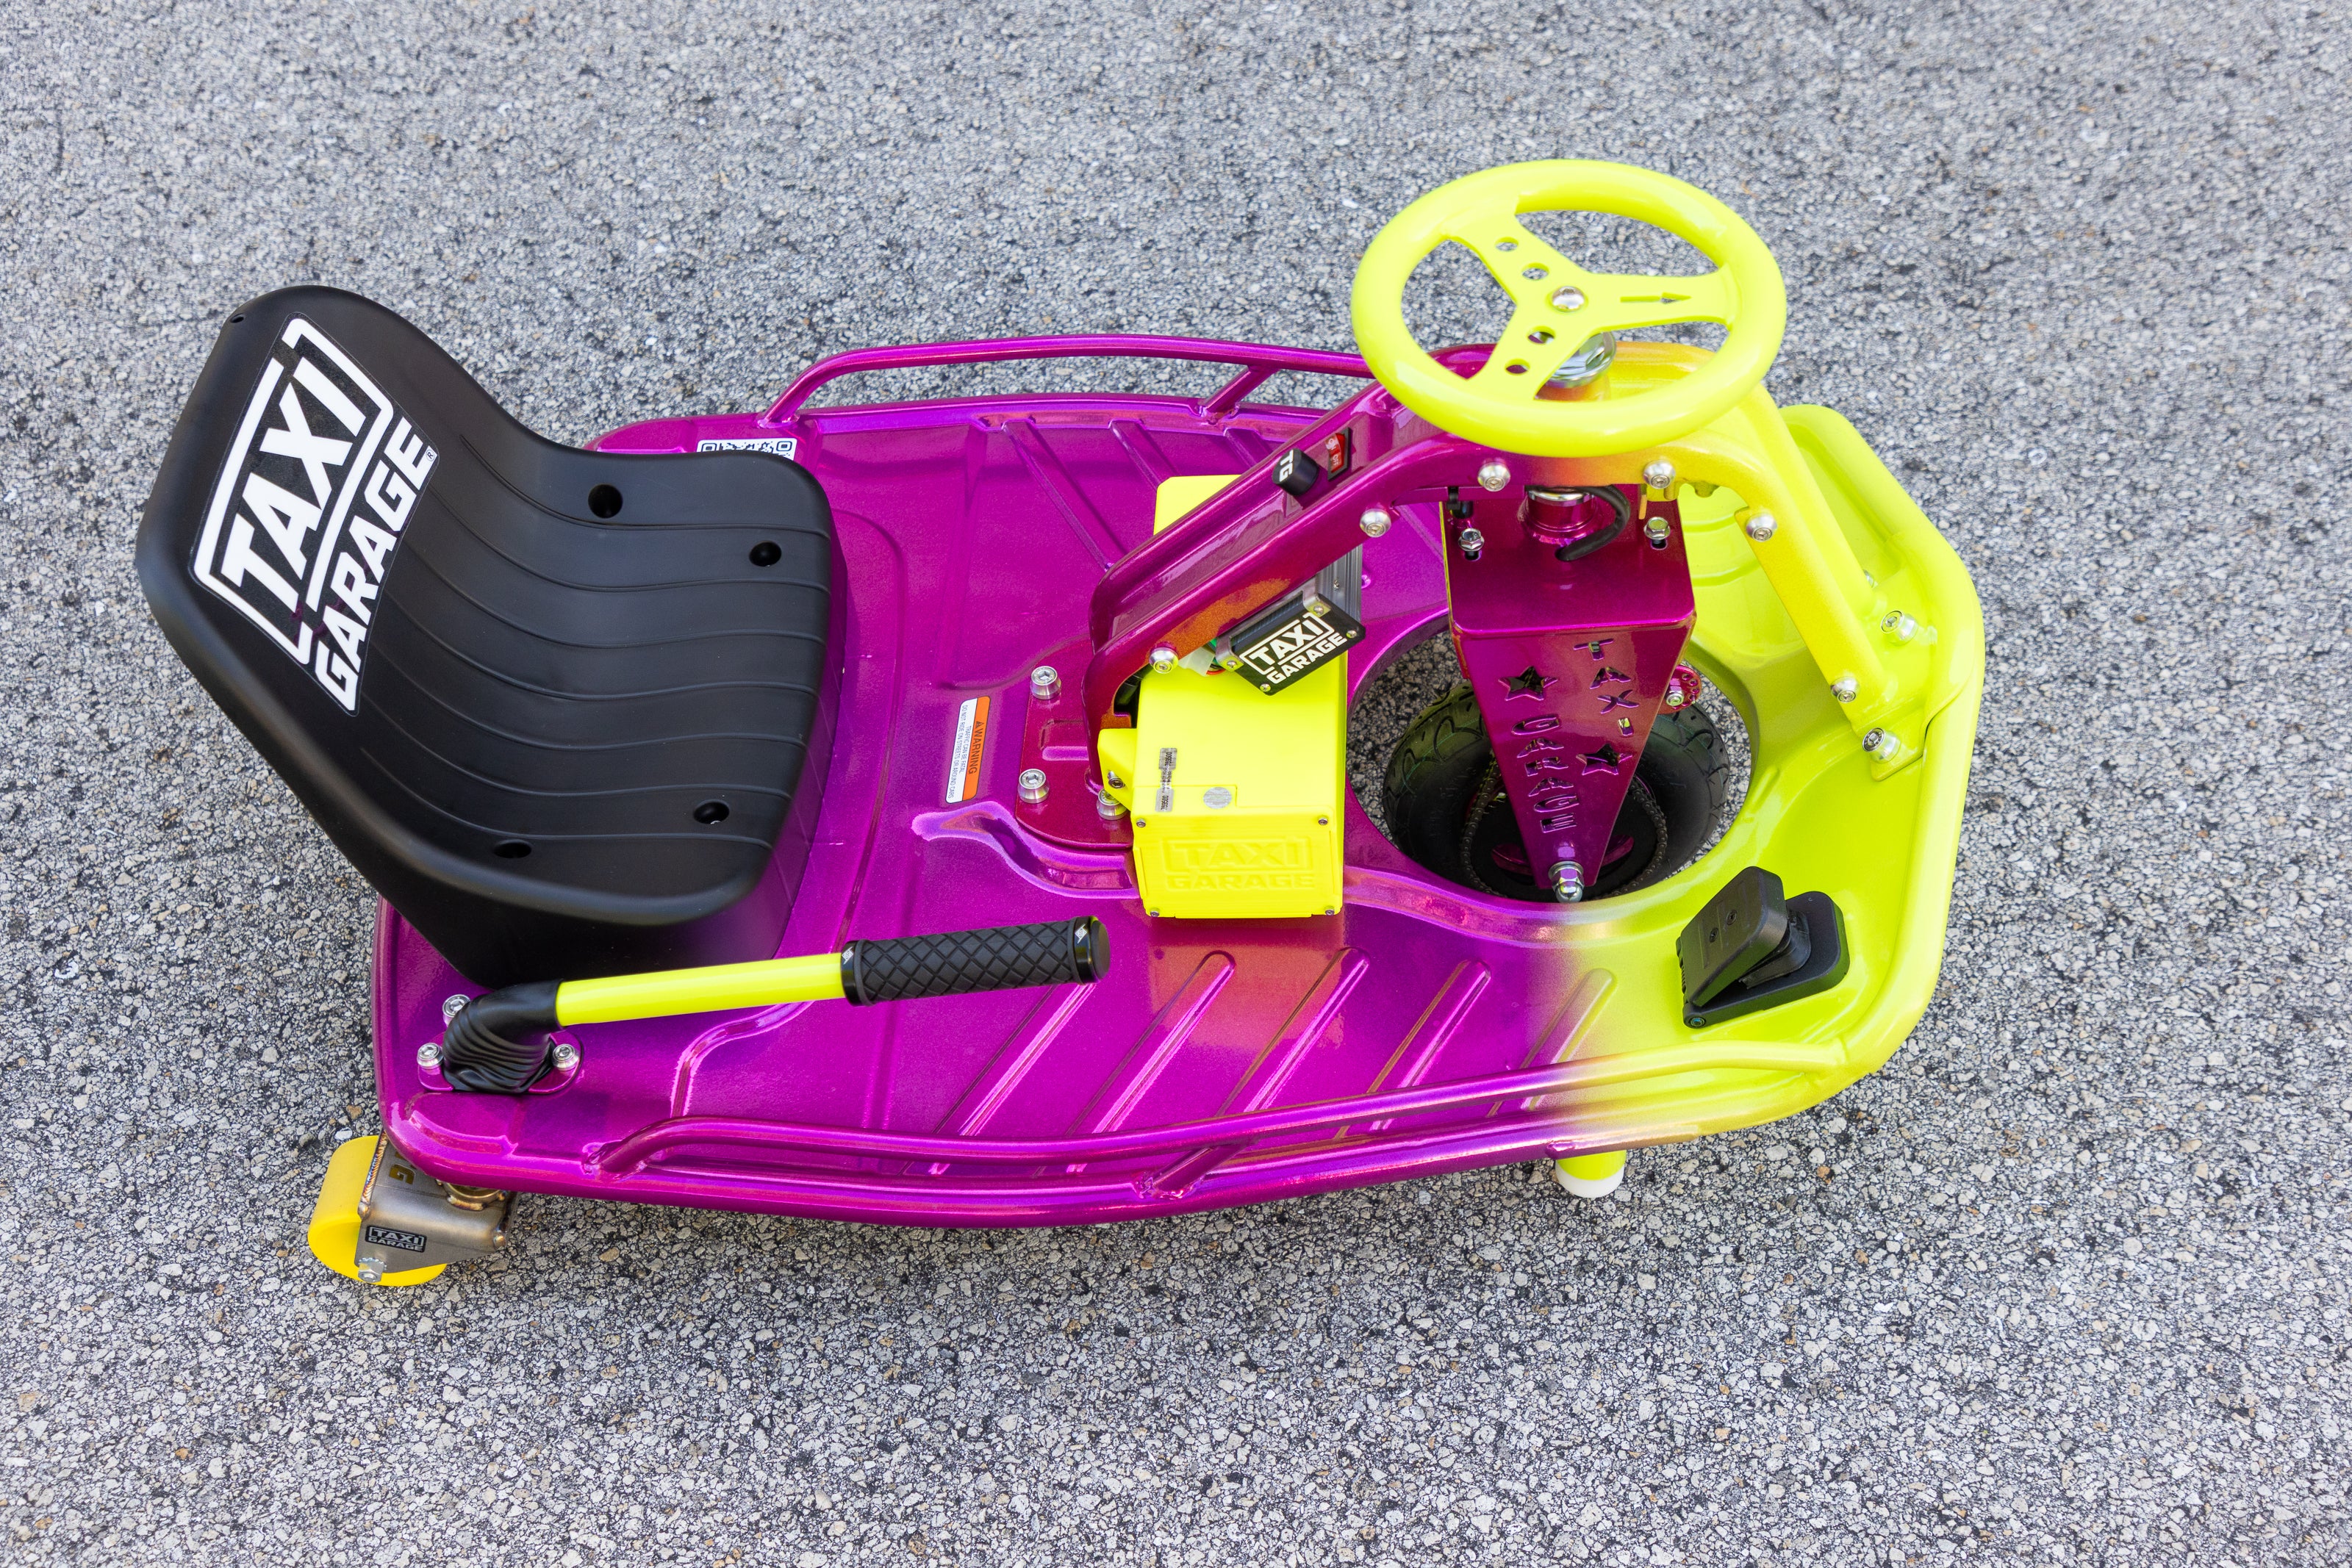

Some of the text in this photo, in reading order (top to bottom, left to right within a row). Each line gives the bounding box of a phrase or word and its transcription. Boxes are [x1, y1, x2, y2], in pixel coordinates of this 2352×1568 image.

[220, 356, 367, 614] TAXI
[1279, 449, 1294, 483] TG
[315, 417, 438, 711] GARAGE
[1248, 619, 1324, 666] TAXI
[1266, 632, 1347, 684] GARAGE
[1573, 638, 1640, 736] TAXI
[954, 739, 962, 759] STREETS
[968, 728, 983, 774] WARNING
[950, 766, 958, 785] AROUND
[1510, 714, 1580, 833] GARAGE
[1173, 841, 1302, 868] TAXI
[1166, 874, 1316, 891] GARAGE
[368, 1237, 423, 1251] GARAGE
[373, 1229, 420, 1244] TAXI
